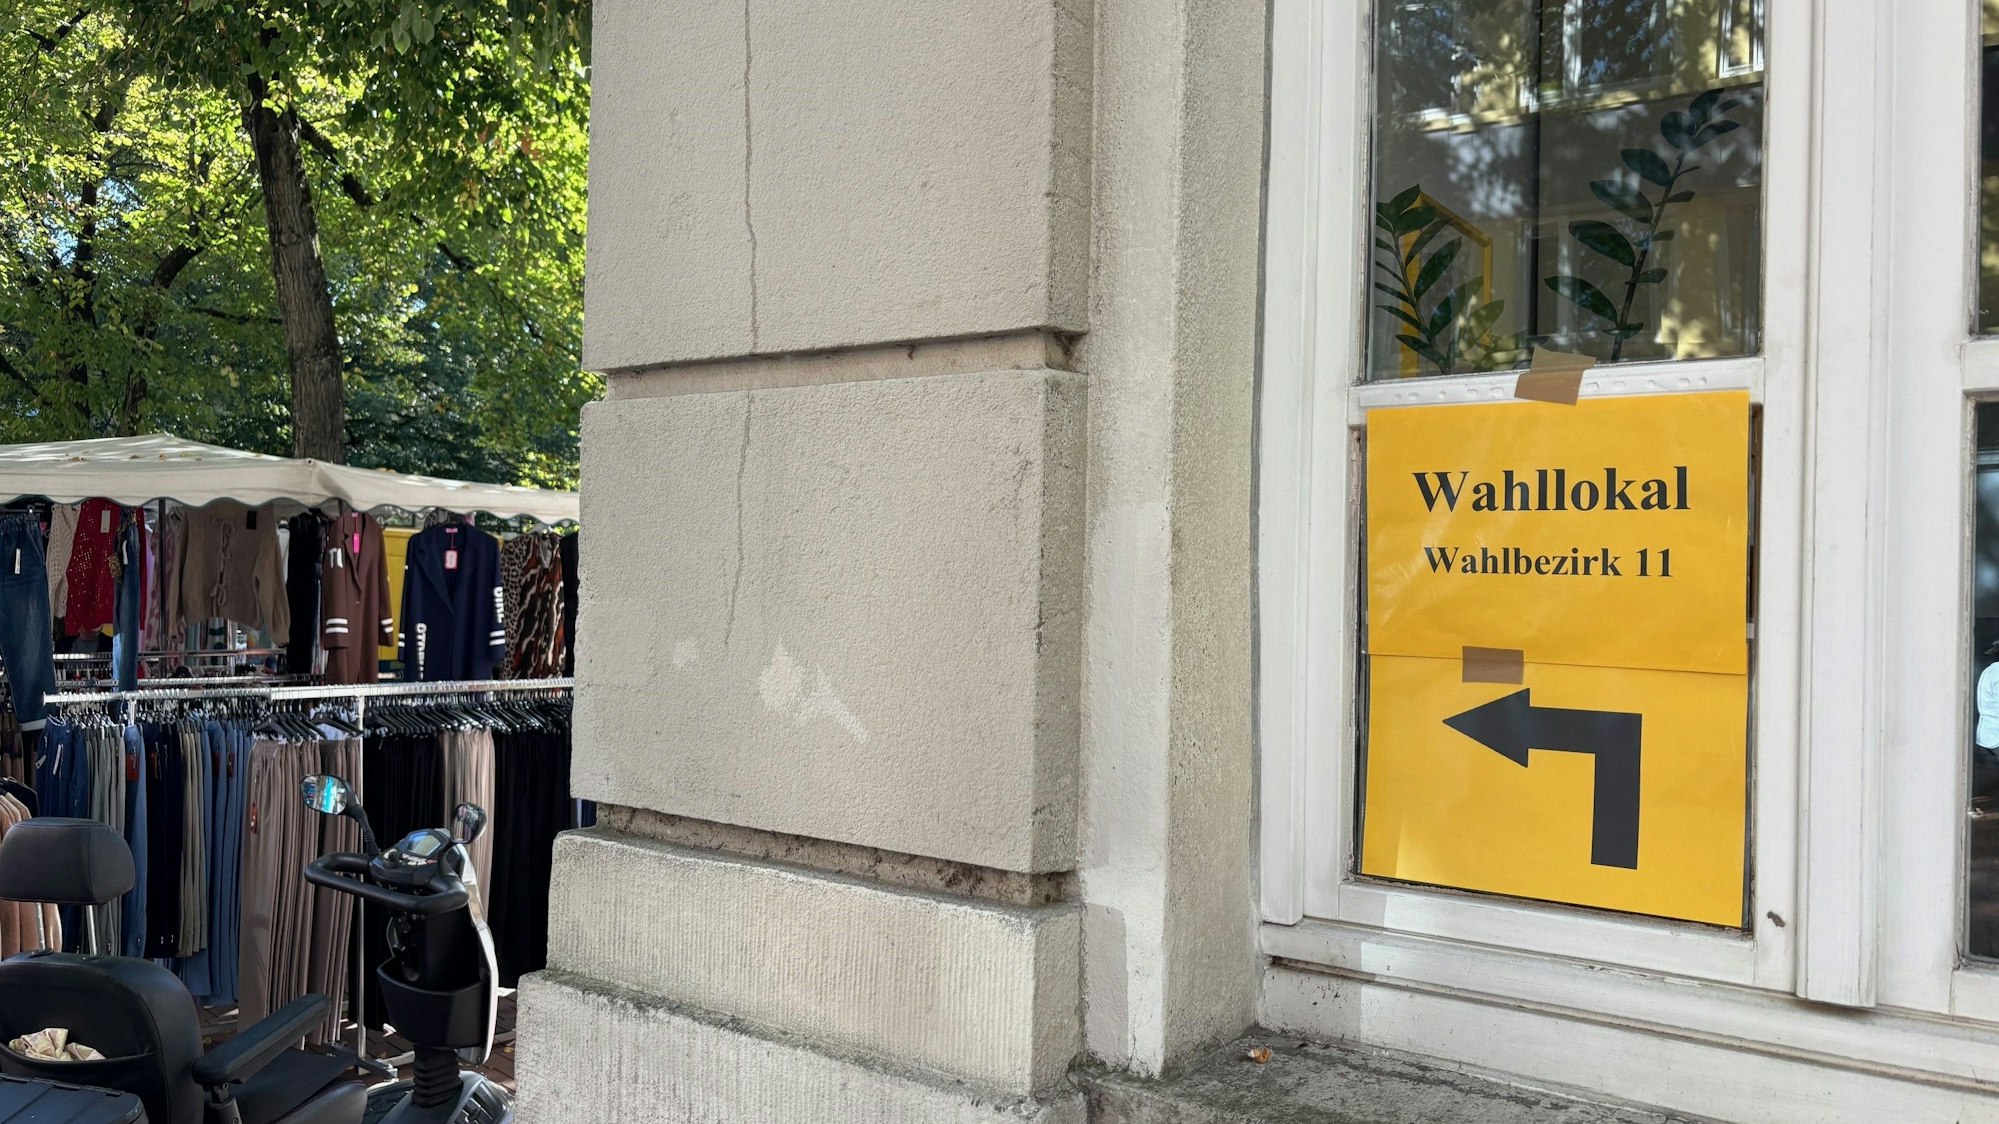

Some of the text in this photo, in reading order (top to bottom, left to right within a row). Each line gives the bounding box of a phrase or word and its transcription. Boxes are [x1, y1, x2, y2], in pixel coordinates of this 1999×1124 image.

[1411, 465, 1691, 513] Wahllokal
[1423, 546, 1673, 578] Wahlbezirk 11
